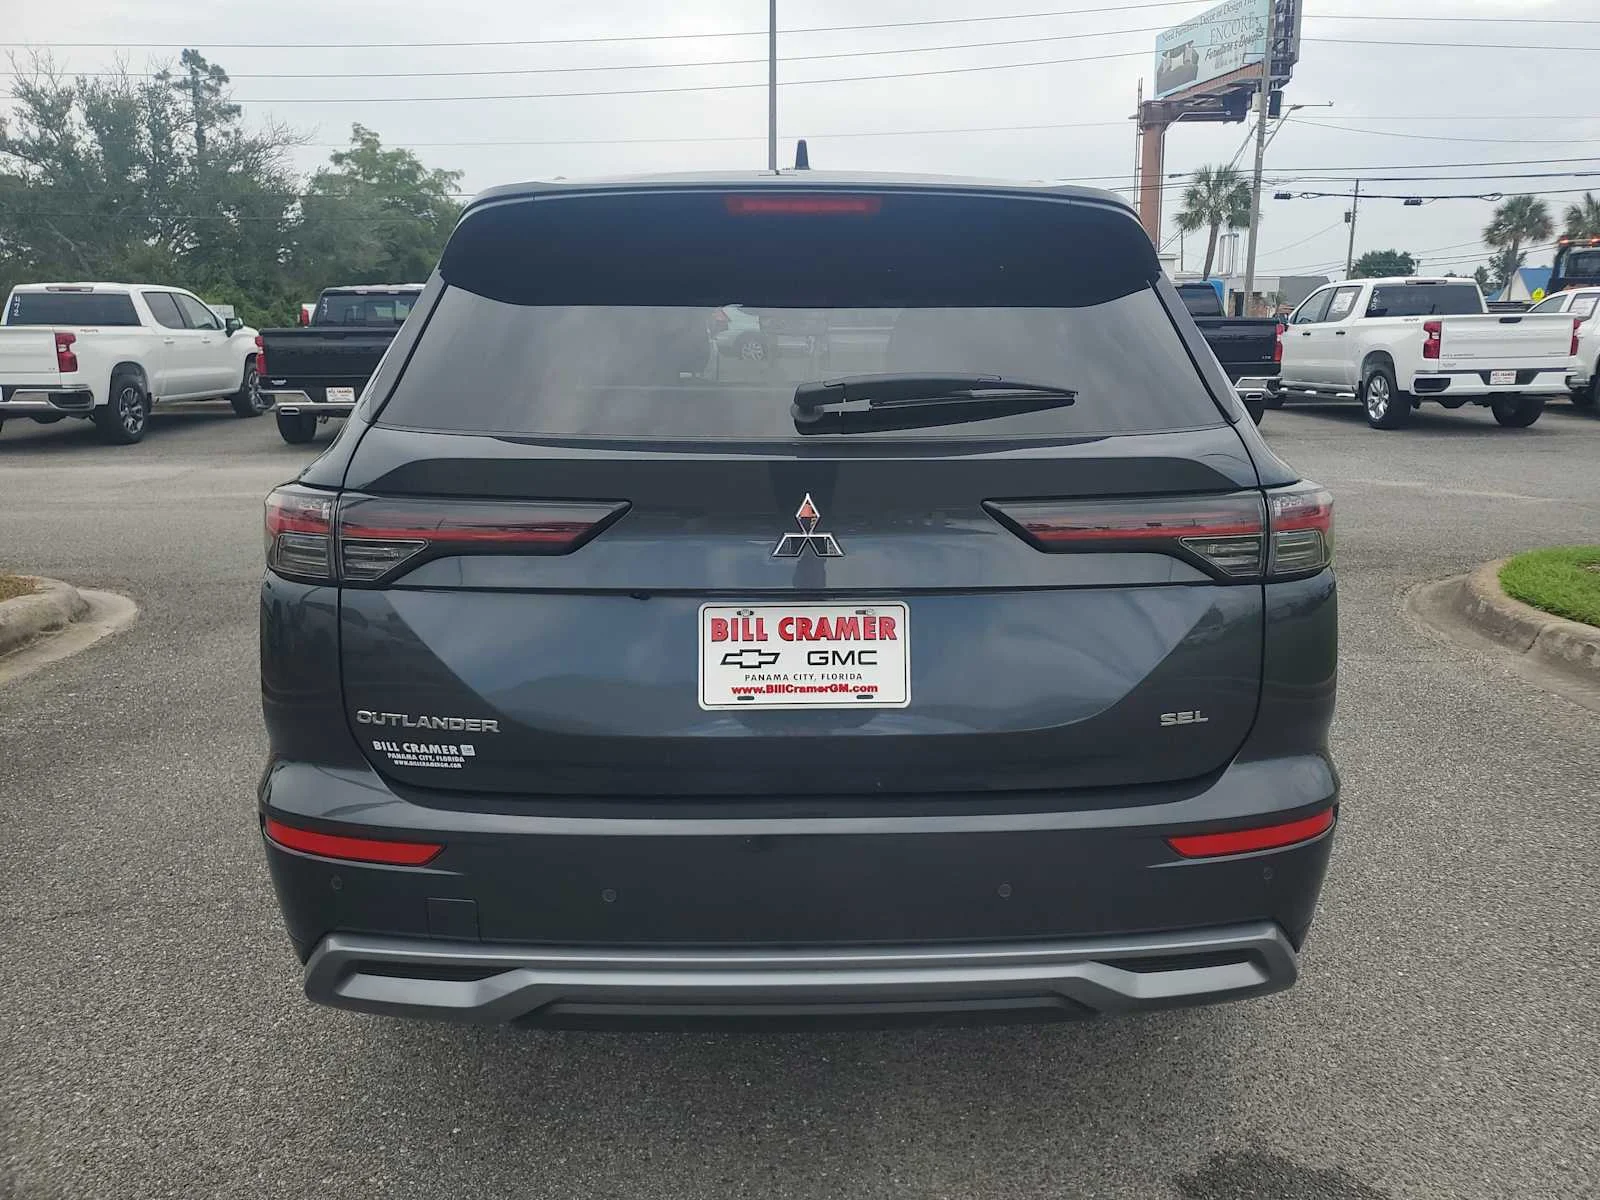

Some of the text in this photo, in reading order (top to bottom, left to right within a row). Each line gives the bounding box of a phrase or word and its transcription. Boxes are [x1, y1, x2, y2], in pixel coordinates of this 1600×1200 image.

[711, 616, 898, 642] BILL CRAMER
[807, 650, 878, 666] GMC
[793, 673, 817, 681] CITY,
[731, 683, 879, 694] www.BillCramerGM.com
[356, 710, 501, 733] OUTLANDER
[1160, 710, 1209, 727] SEL
[372, 740, 400, 752] BILL
[402, 742, 459, 755] CRAMER
[387, 752, 465, 763] PANAMA CITY, FLORIDA
